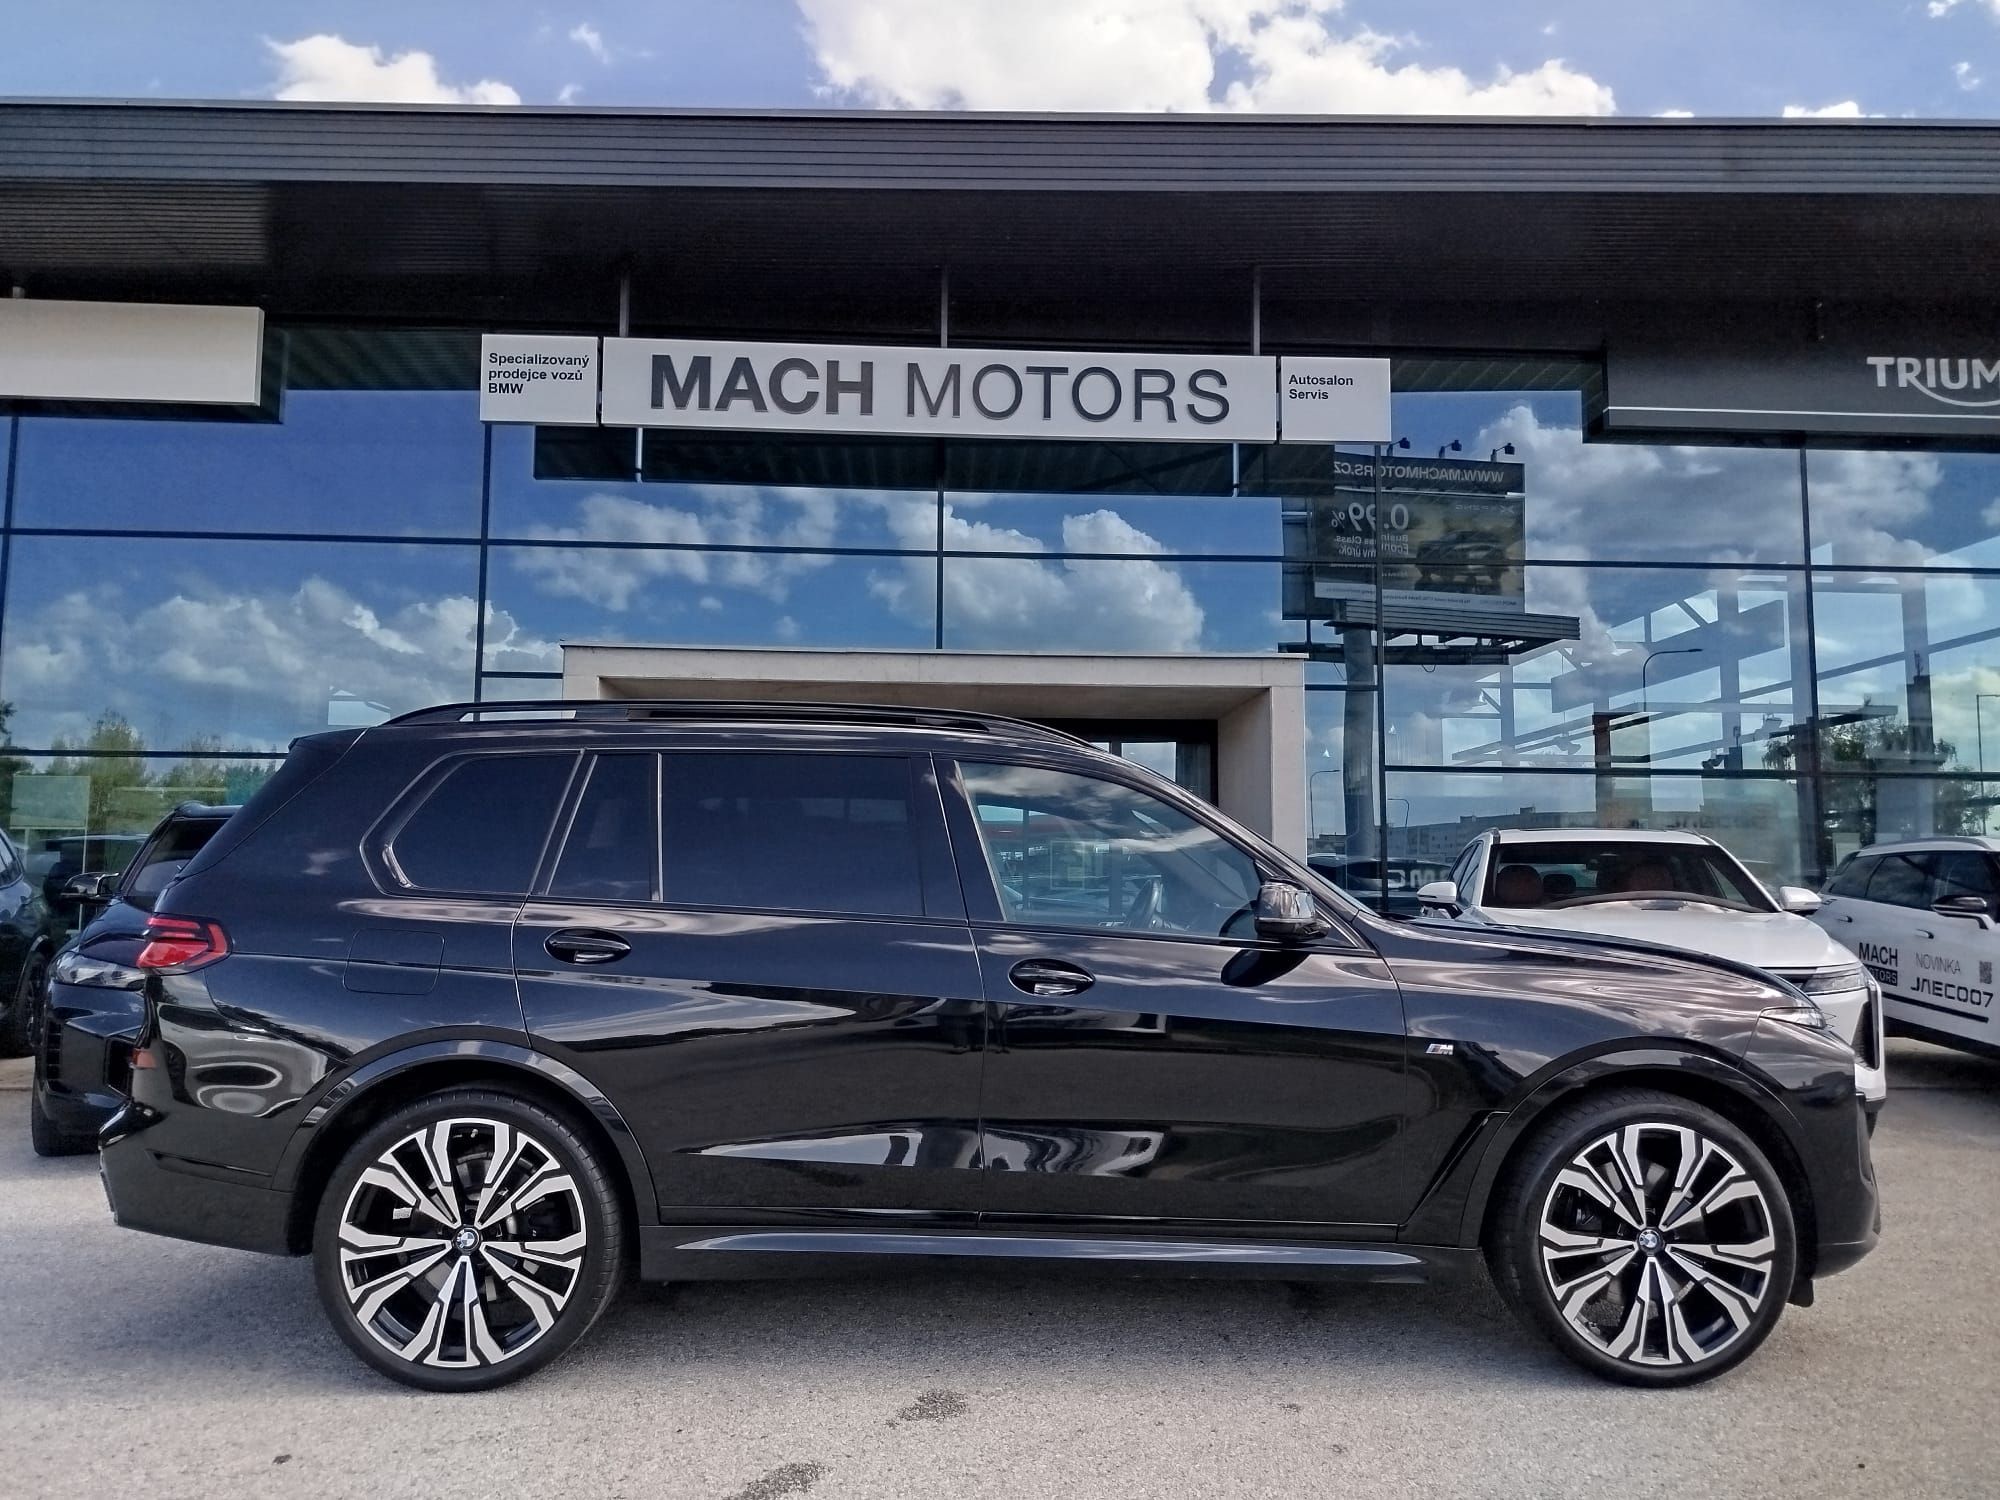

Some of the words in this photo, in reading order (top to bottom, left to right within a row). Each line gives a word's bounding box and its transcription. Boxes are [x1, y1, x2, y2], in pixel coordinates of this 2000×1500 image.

[489, 352, 590, 368] Specializovaný
[488, 368, 547, 382] prodejce
[551, 369, 583, 381] vozů
[1289, 374, 1353, 387] Autosalon
[488, 382, 524, 394] BMW
[651, 354, 874, 415] MACH
[907, 361, 1230, 425] MOTORS
[1289, 388, 1329, 400] Servis
[1858, 942, 1898, 967] MACH
[1915, 952, 1961, 975] NOVINKA
[1866, 967, 1897, 984] OTORS
